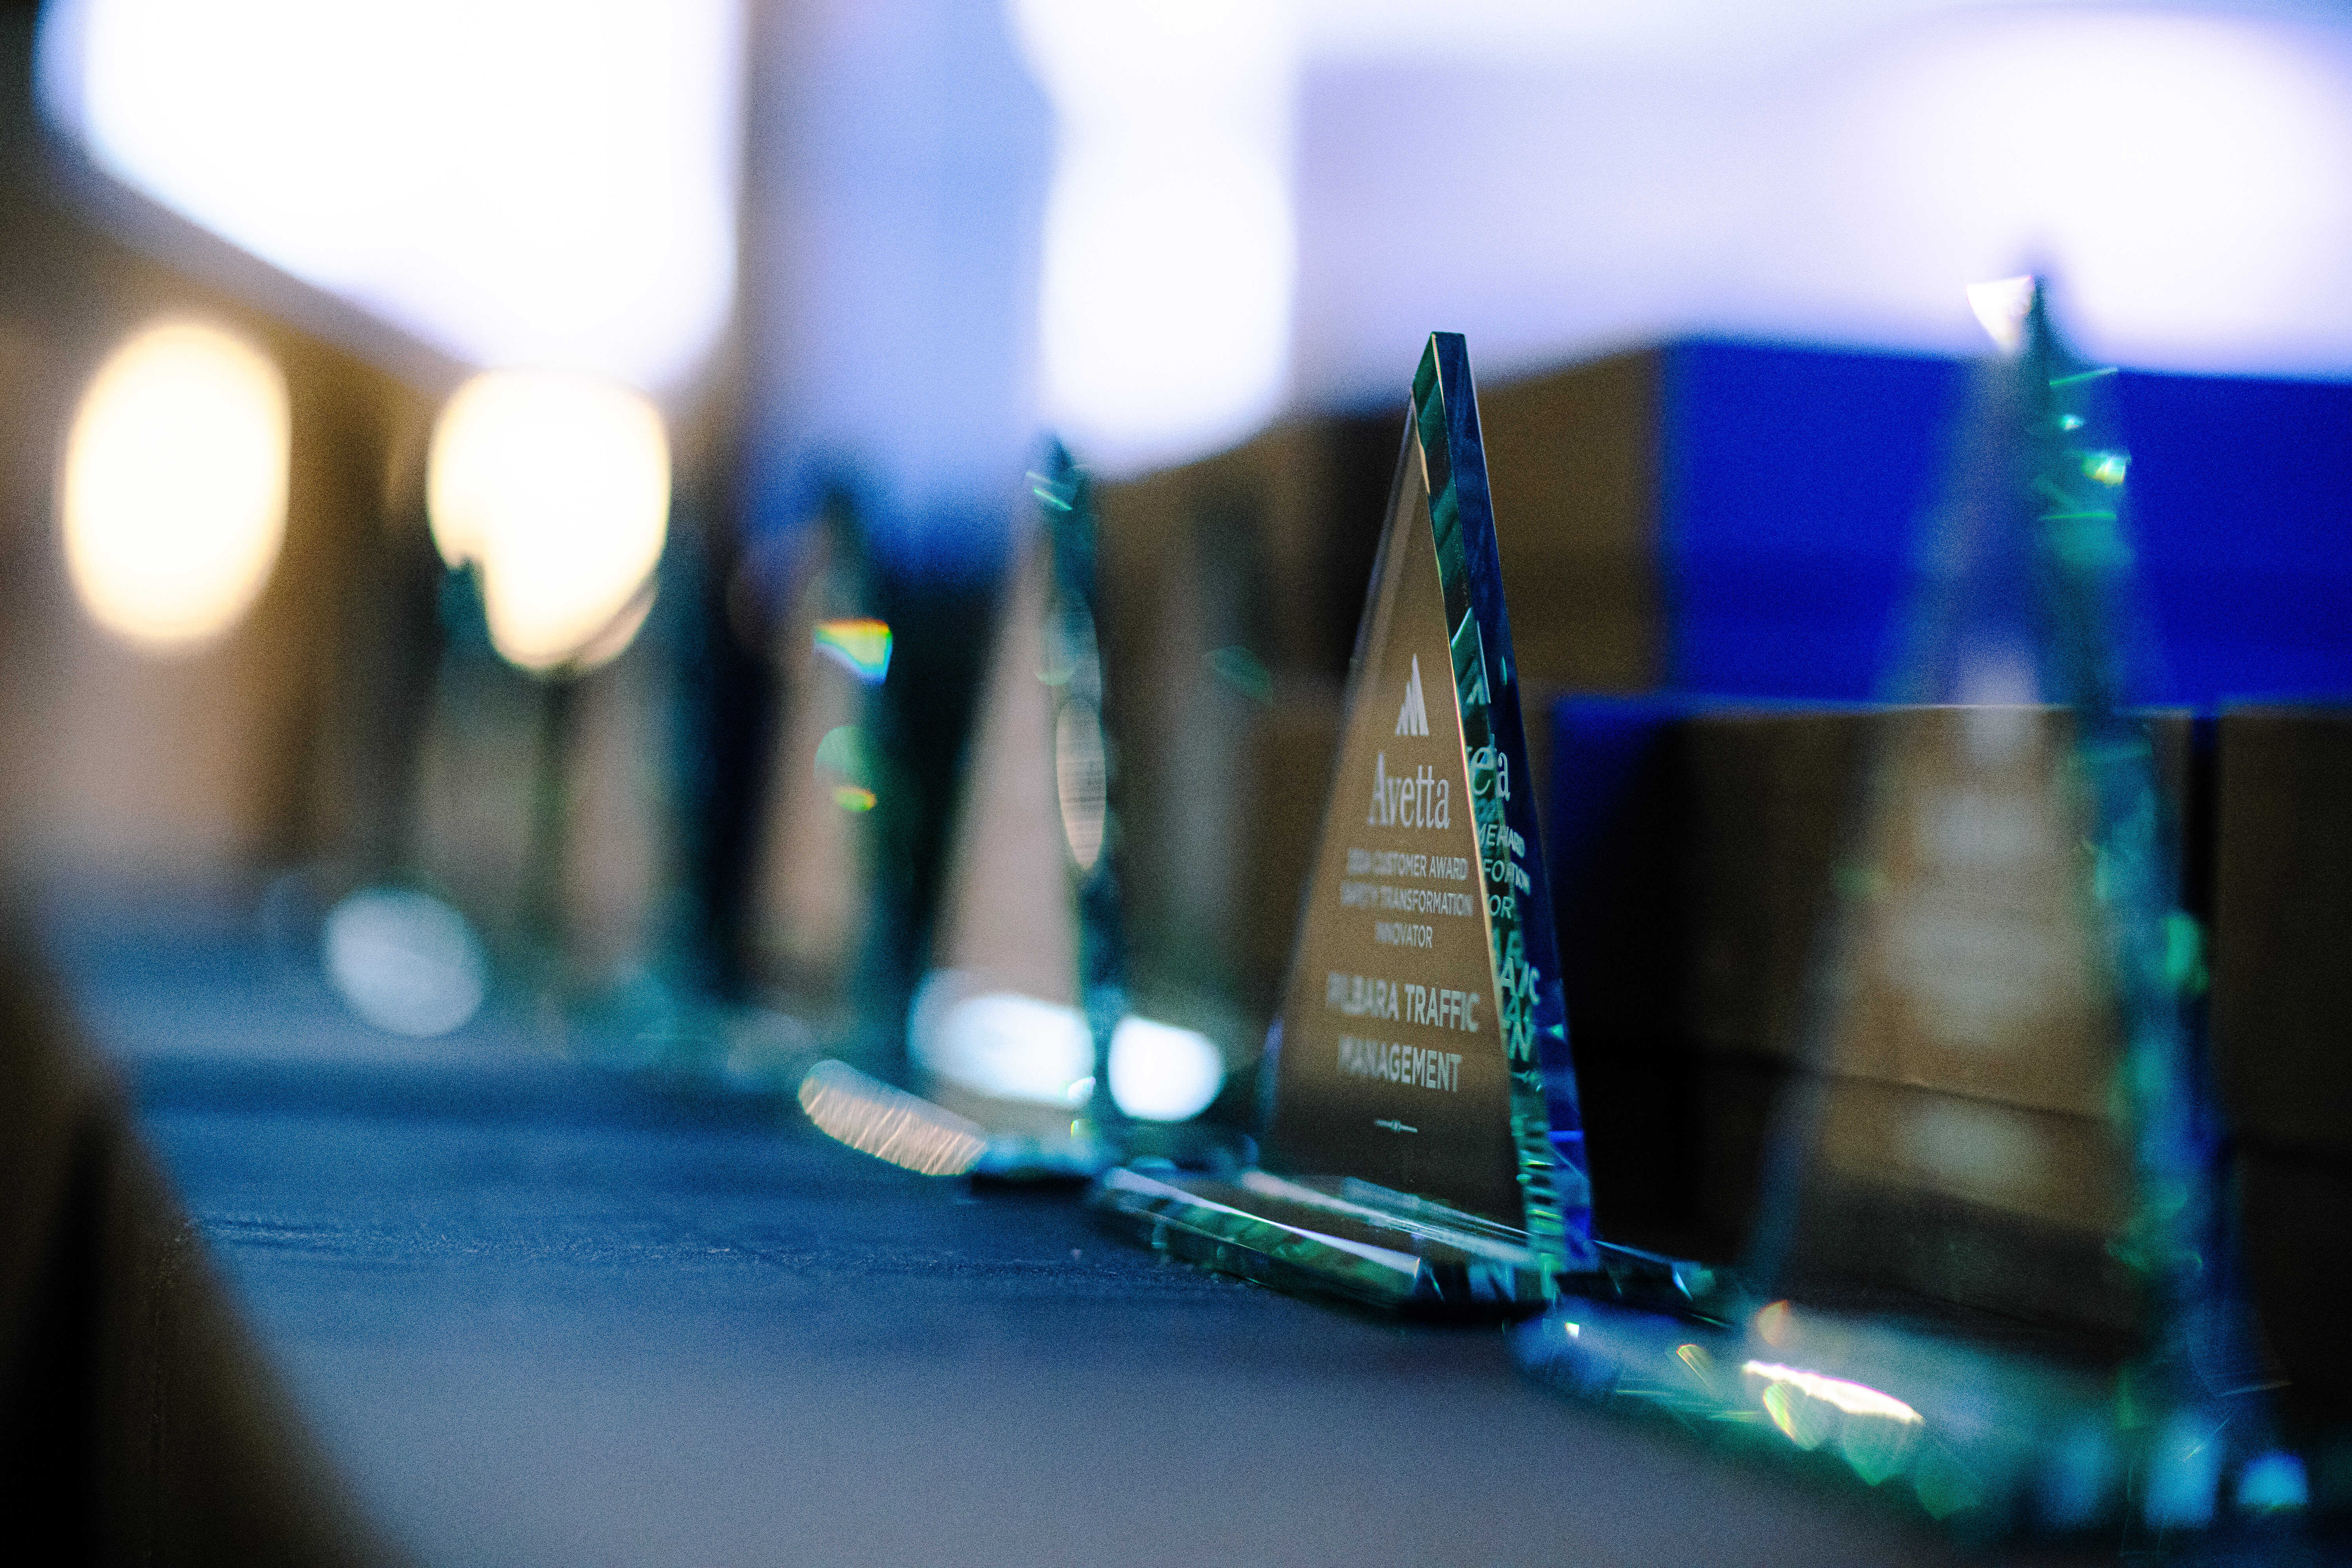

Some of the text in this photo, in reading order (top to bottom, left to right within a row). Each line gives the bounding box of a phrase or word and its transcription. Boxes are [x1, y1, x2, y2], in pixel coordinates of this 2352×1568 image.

[1367, 751, 1450, 829] Avetta
[1429, 856, 1468, 881] AWARD
[1375, 922, 1433, 949] OVATOR
[1404, 983, 1480, 1032] TRAFFIC
[1338, 1035, 1462, 1092] MANAGEMENT
